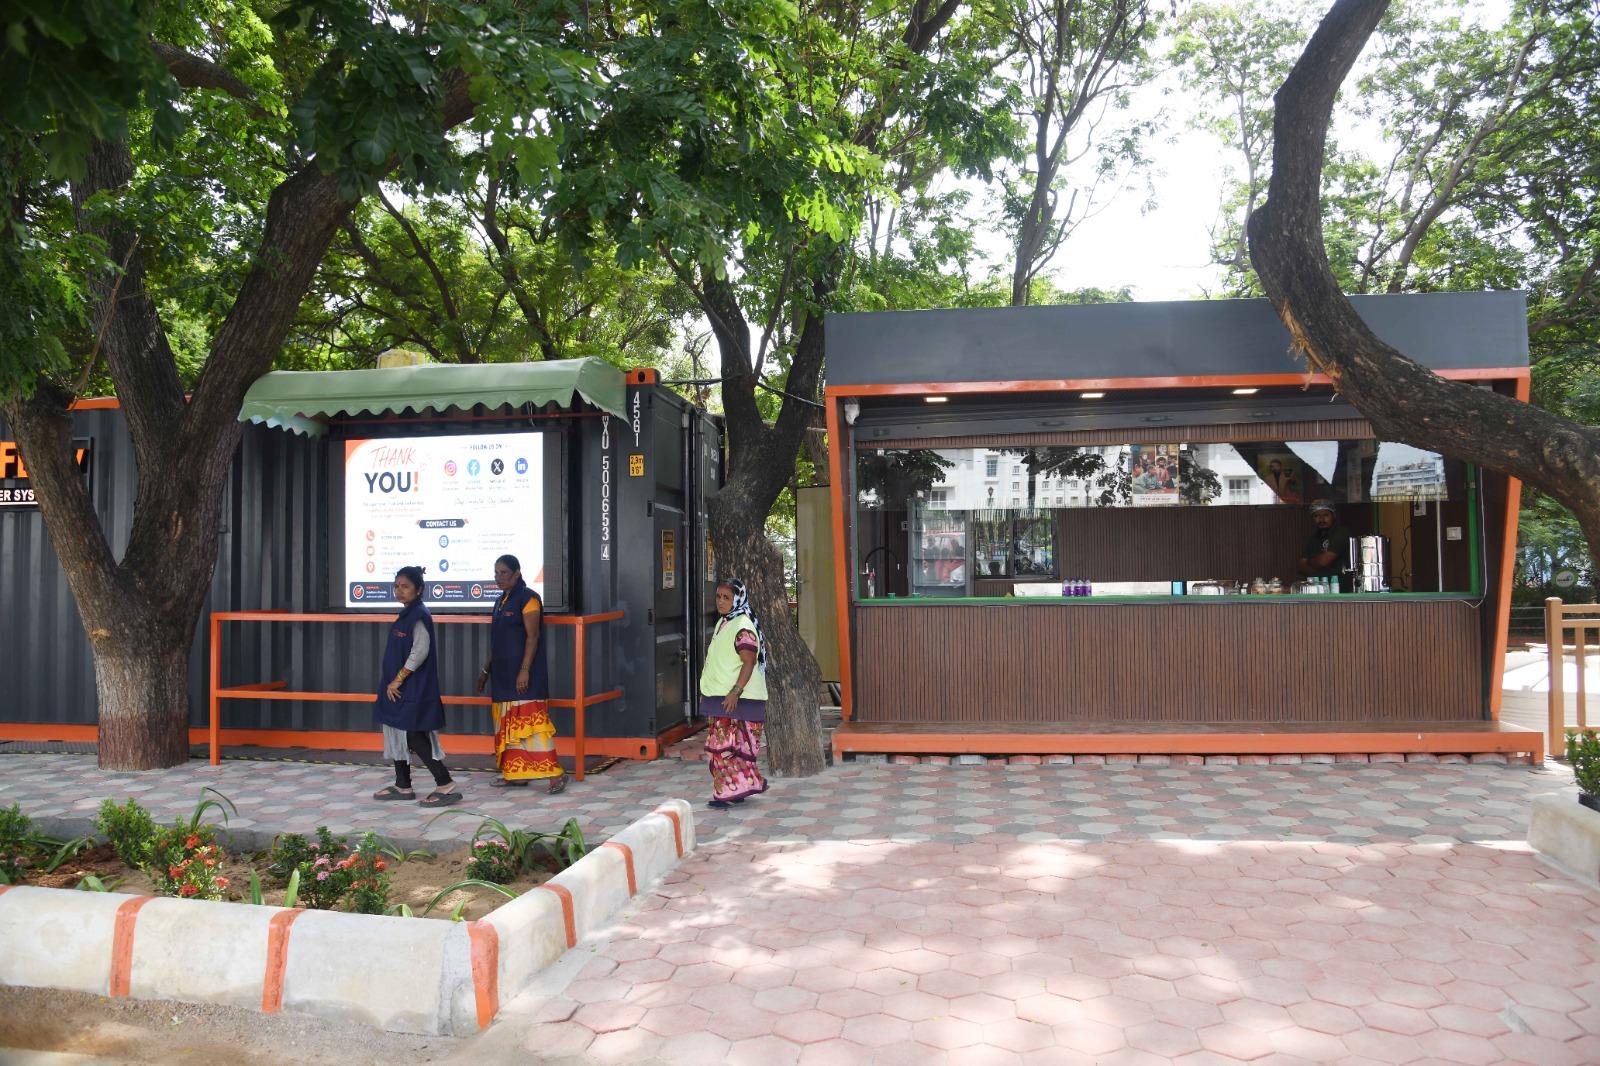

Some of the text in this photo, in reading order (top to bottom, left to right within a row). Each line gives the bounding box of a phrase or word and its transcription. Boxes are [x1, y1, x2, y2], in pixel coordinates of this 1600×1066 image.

[633, 391, 641, 447] 45G1
[370, 445, 416, 467] THANK
[469, 443, 487, 451] FOLLOW
[364, 471, 419, 493] YOU!
[601, 455, 610, 541] 500653
[425, 520, 448, 528] CONTACT
